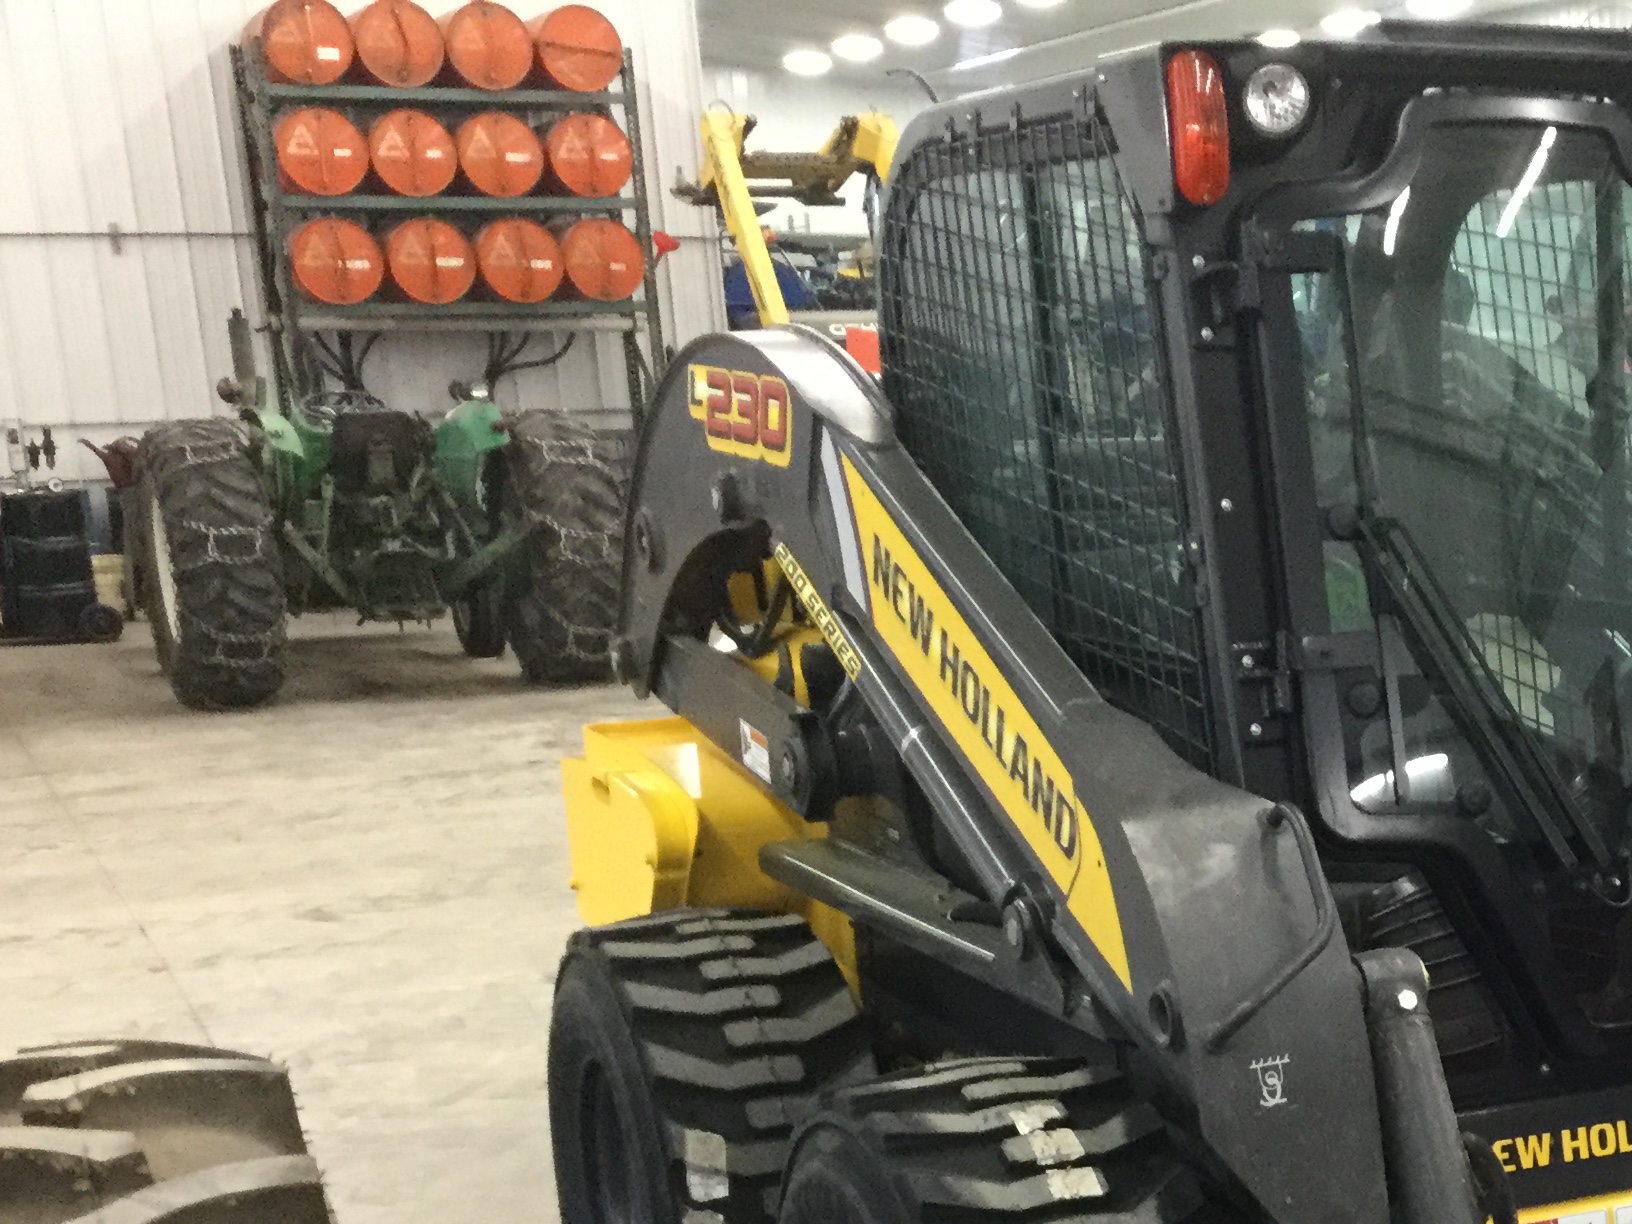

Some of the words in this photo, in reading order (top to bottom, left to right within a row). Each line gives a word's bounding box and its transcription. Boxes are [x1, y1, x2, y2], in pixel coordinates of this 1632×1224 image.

[775, 543, 807, 593] 200
[804, 592, 860, 676] SERIES
[872, 533, 934, 657] NEW
[939, 627, 1077, 861] HOLLAND
[1492, 1132, 1551, 1173] EW
